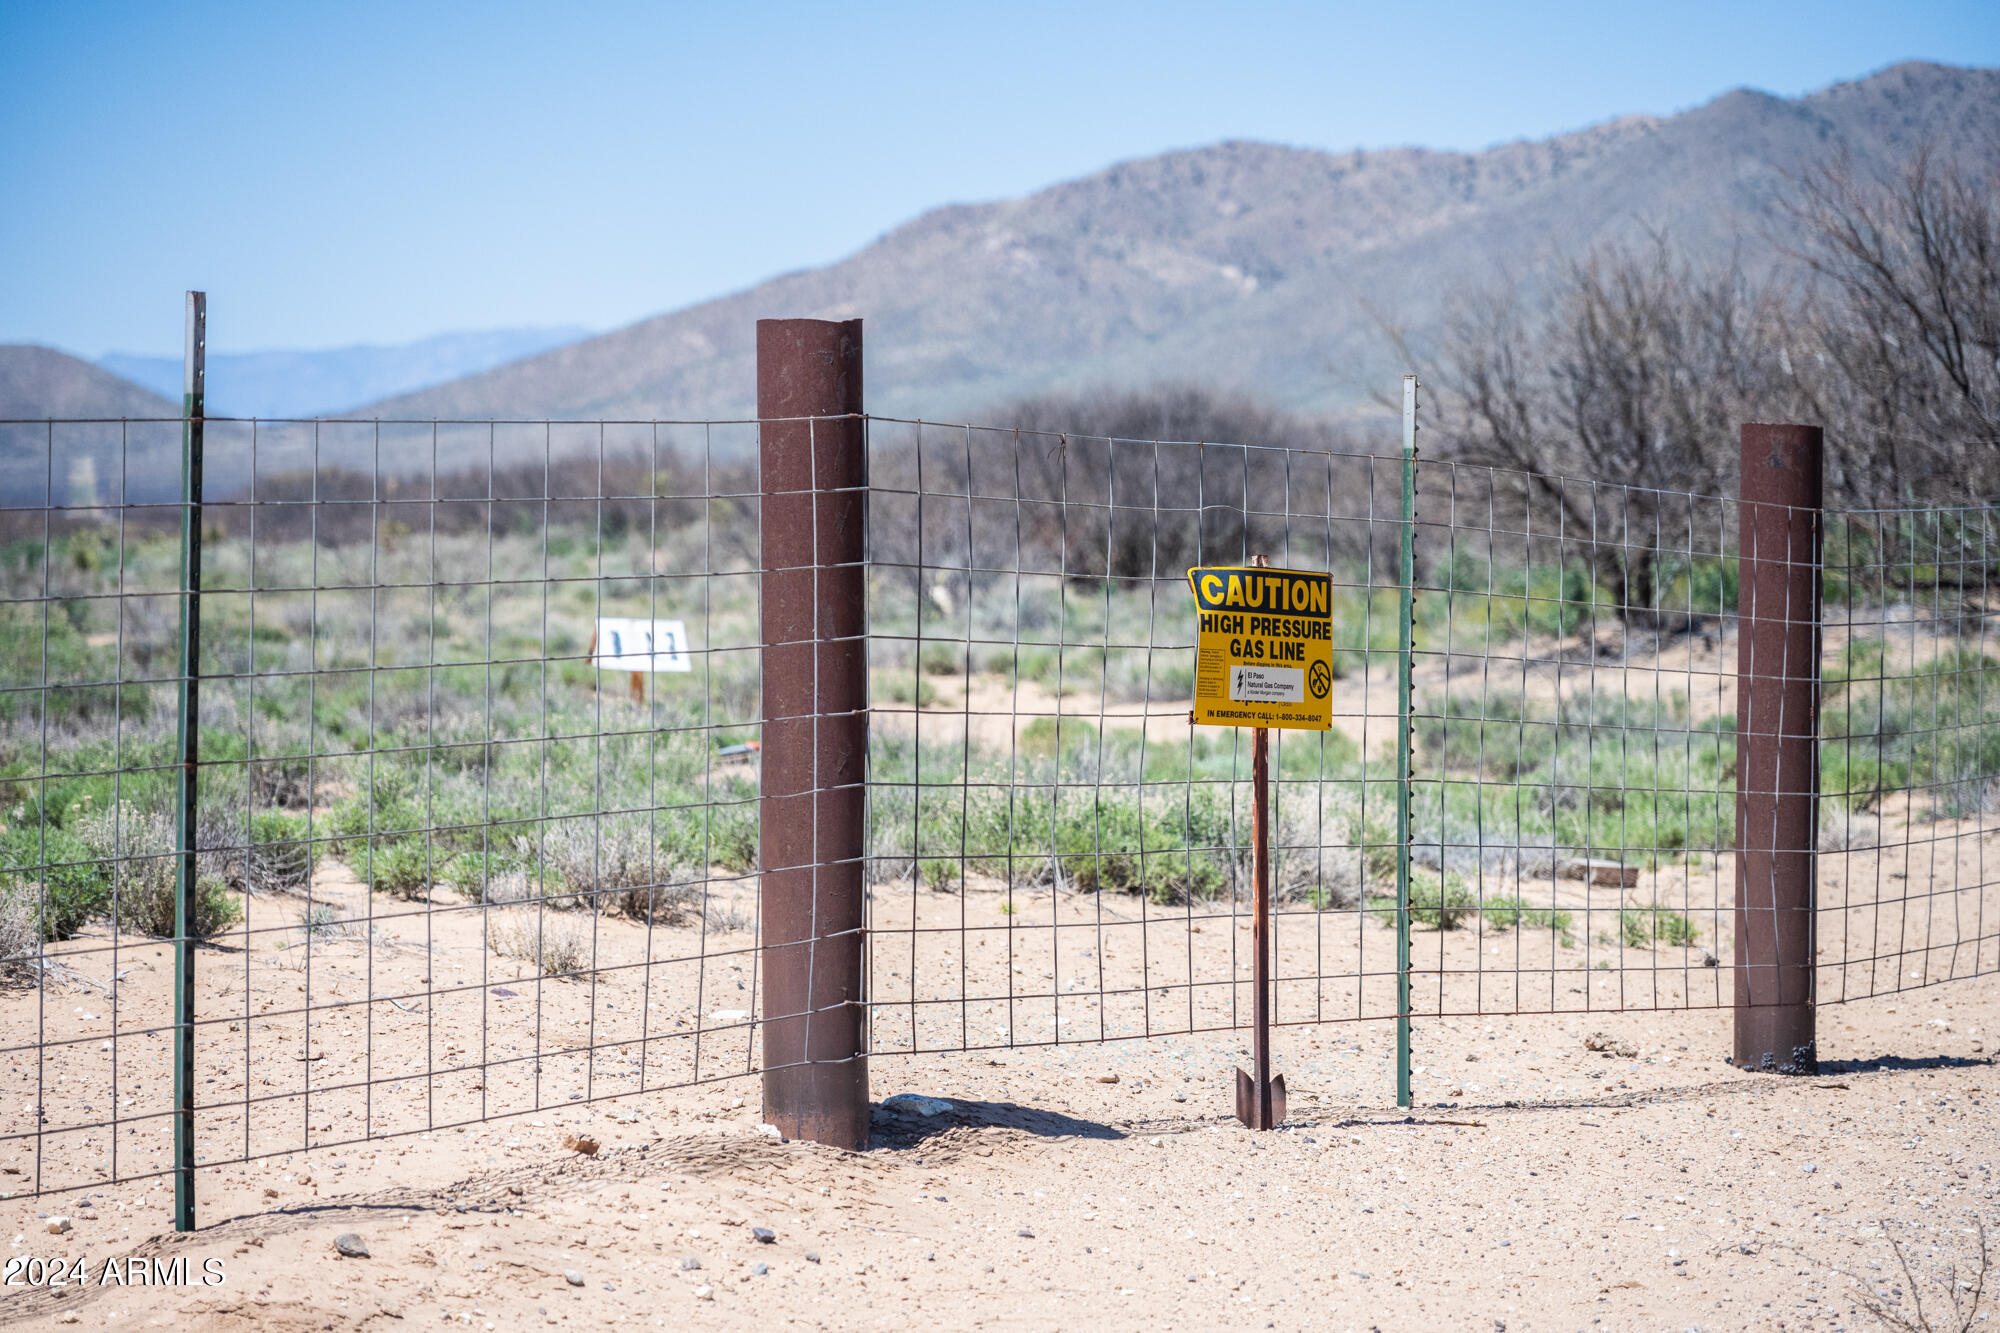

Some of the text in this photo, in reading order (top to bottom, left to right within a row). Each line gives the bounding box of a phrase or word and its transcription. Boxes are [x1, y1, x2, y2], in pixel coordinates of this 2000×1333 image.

[1201, 574, 1328, 613] CAUTION
[1200, 614, 1332, 640] HIGH PRESSURE
[1230, 638, 1306, 661] GAS LINE
[1253, 672, 1265, 680] Paso
[1274, 683, 1295, 691] Company
[1216, 710, 1256, 719] EMERGENCY
[1257, 712, 1275, 720] CALL:
